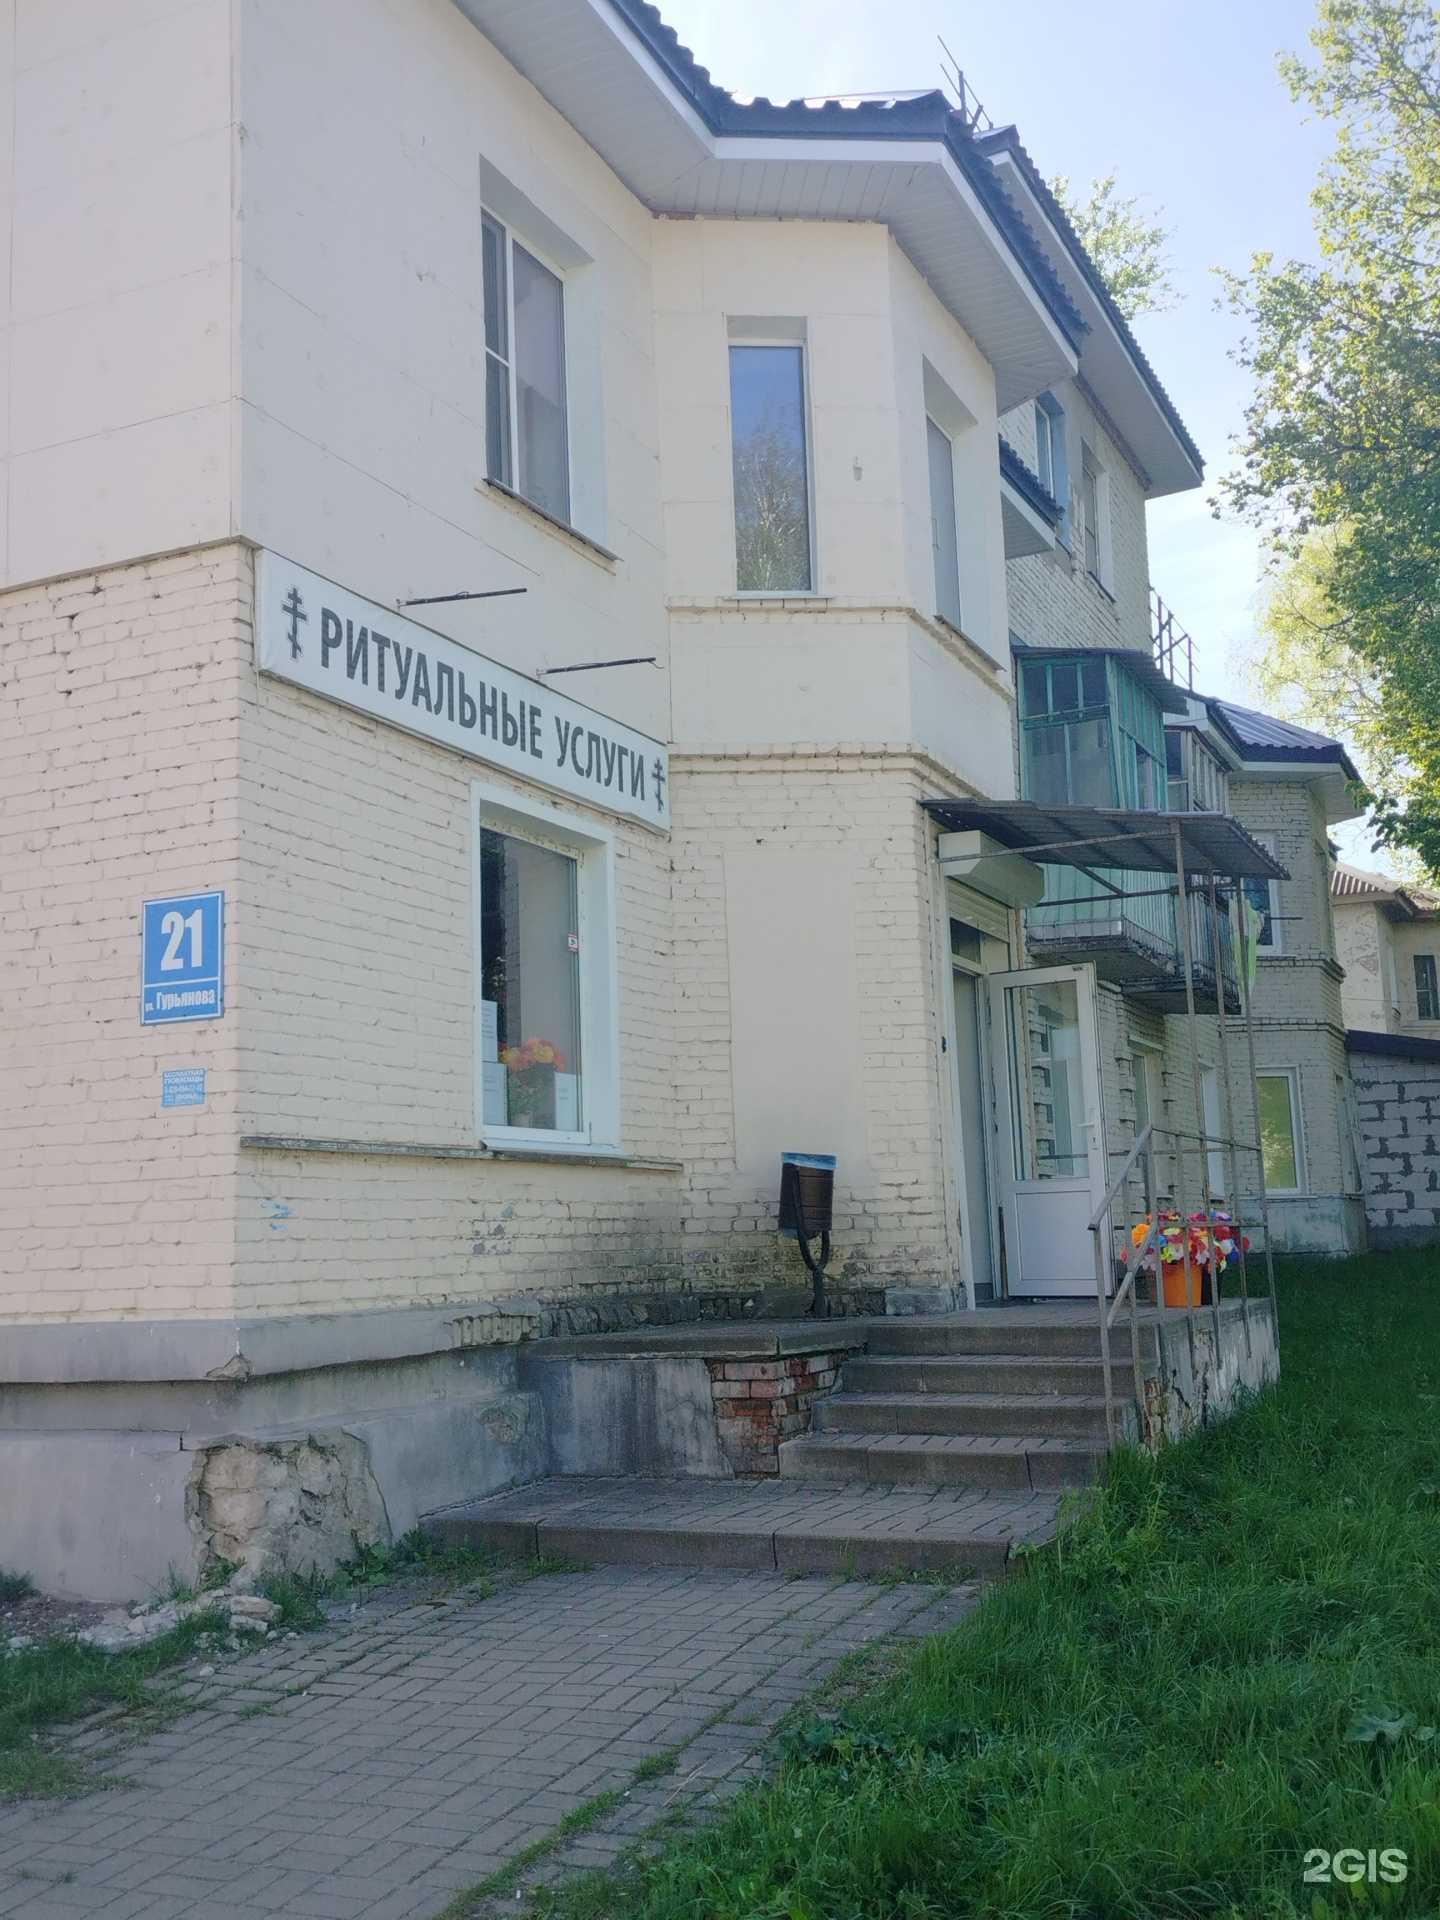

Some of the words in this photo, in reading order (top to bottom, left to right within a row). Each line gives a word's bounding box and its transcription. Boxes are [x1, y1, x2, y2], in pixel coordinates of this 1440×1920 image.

[321, 606, 543, 759] РИТУАЛЬНЫЕ
[555, 715, 646, 801] УСЛУГИ
[160, 908, 203, 971] 21
[156, 988, 216, 1010] Гурьянова
